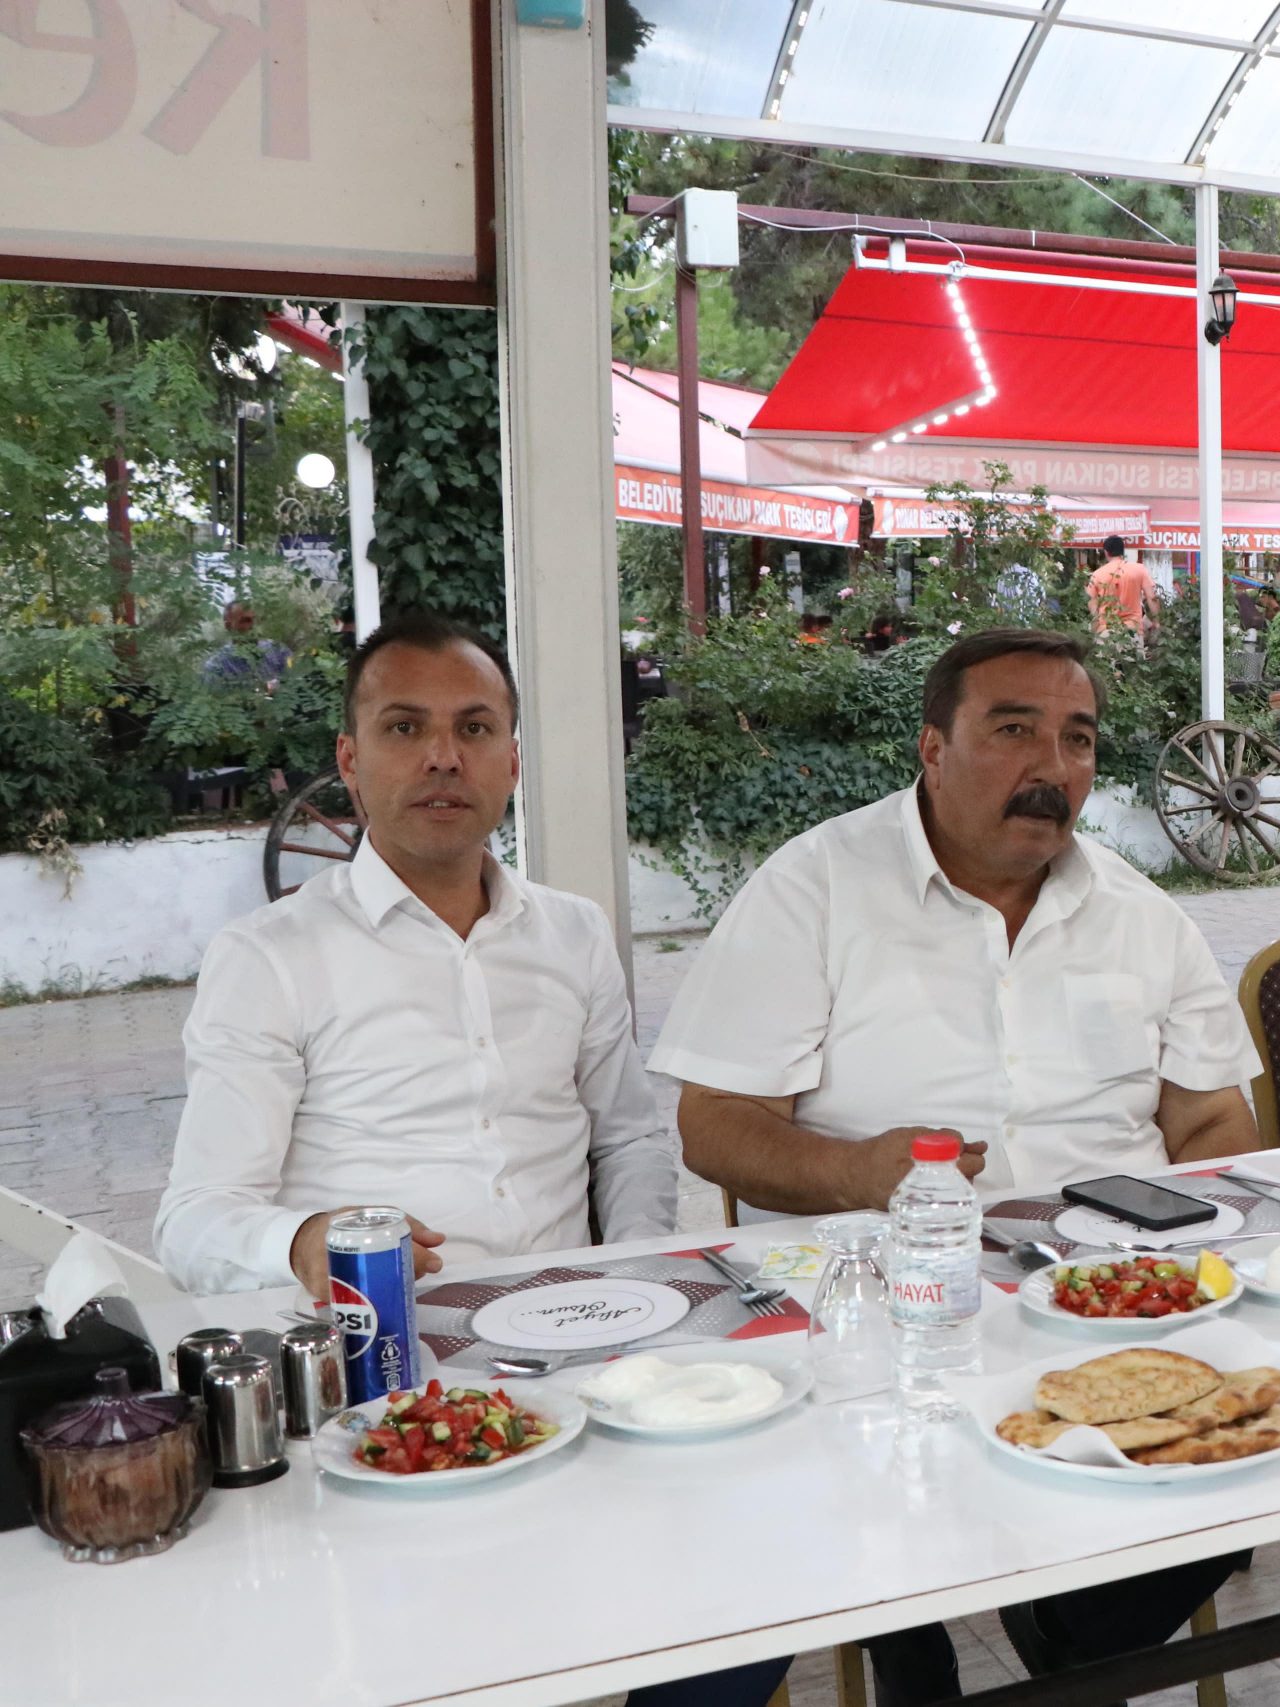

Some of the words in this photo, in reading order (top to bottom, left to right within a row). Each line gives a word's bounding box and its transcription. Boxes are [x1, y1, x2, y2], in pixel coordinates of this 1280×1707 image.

[618, 478, 683, 514] BELEDİYE
[700, 491, 751, 526] SUÇIKAN
[752, 500, 782, 527] PARK
[783, 502, 833, 535] TESİSLERİ
[1222, 535, 1249, 548] ARK
[894, 1281, 945, 1303] HAYAT
